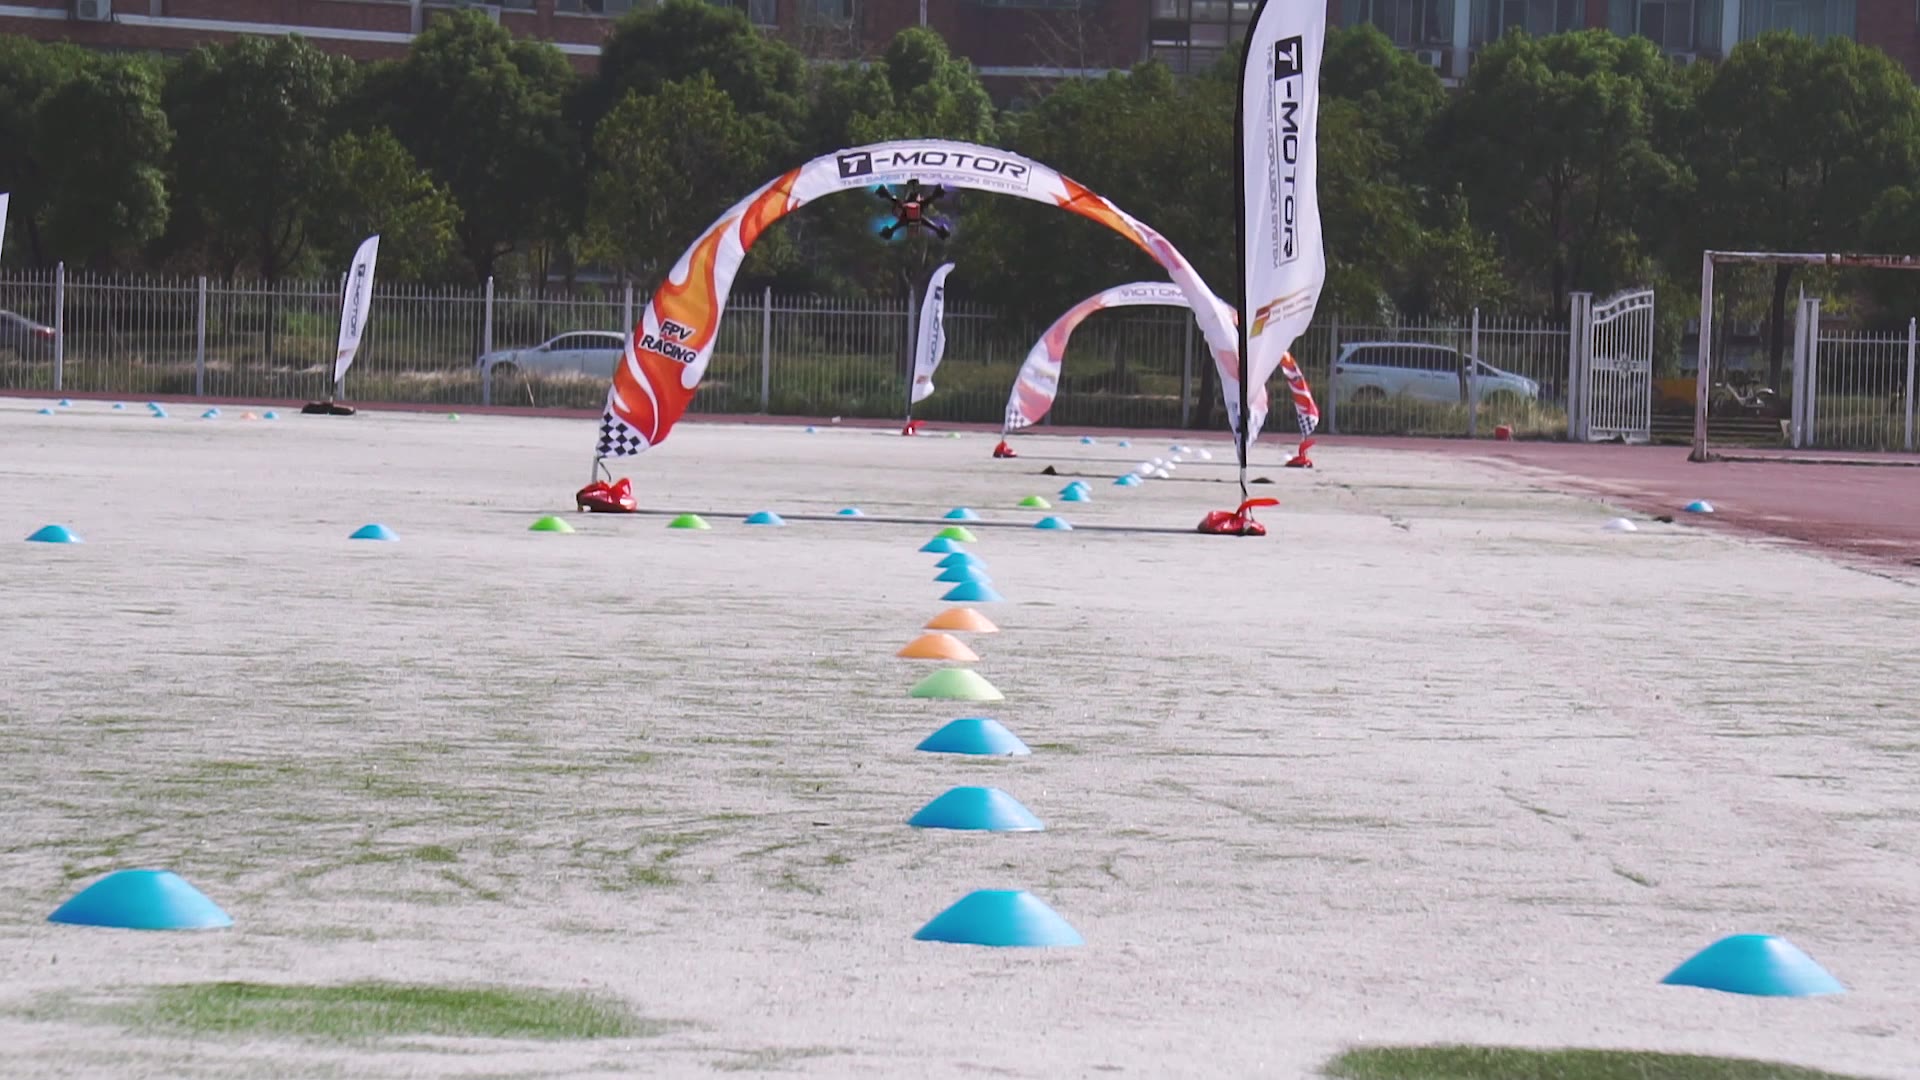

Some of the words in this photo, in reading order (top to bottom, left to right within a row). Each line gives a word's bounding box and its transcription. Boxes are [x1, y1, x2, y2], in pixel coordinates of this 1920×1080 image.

[1276, 37, 1301, 257] T-MOTOR
[838, 151, 1027, 179] T-MOTOR
[661, 320, 692, 340] FPV
[641, 334, 697, 363] RACING
